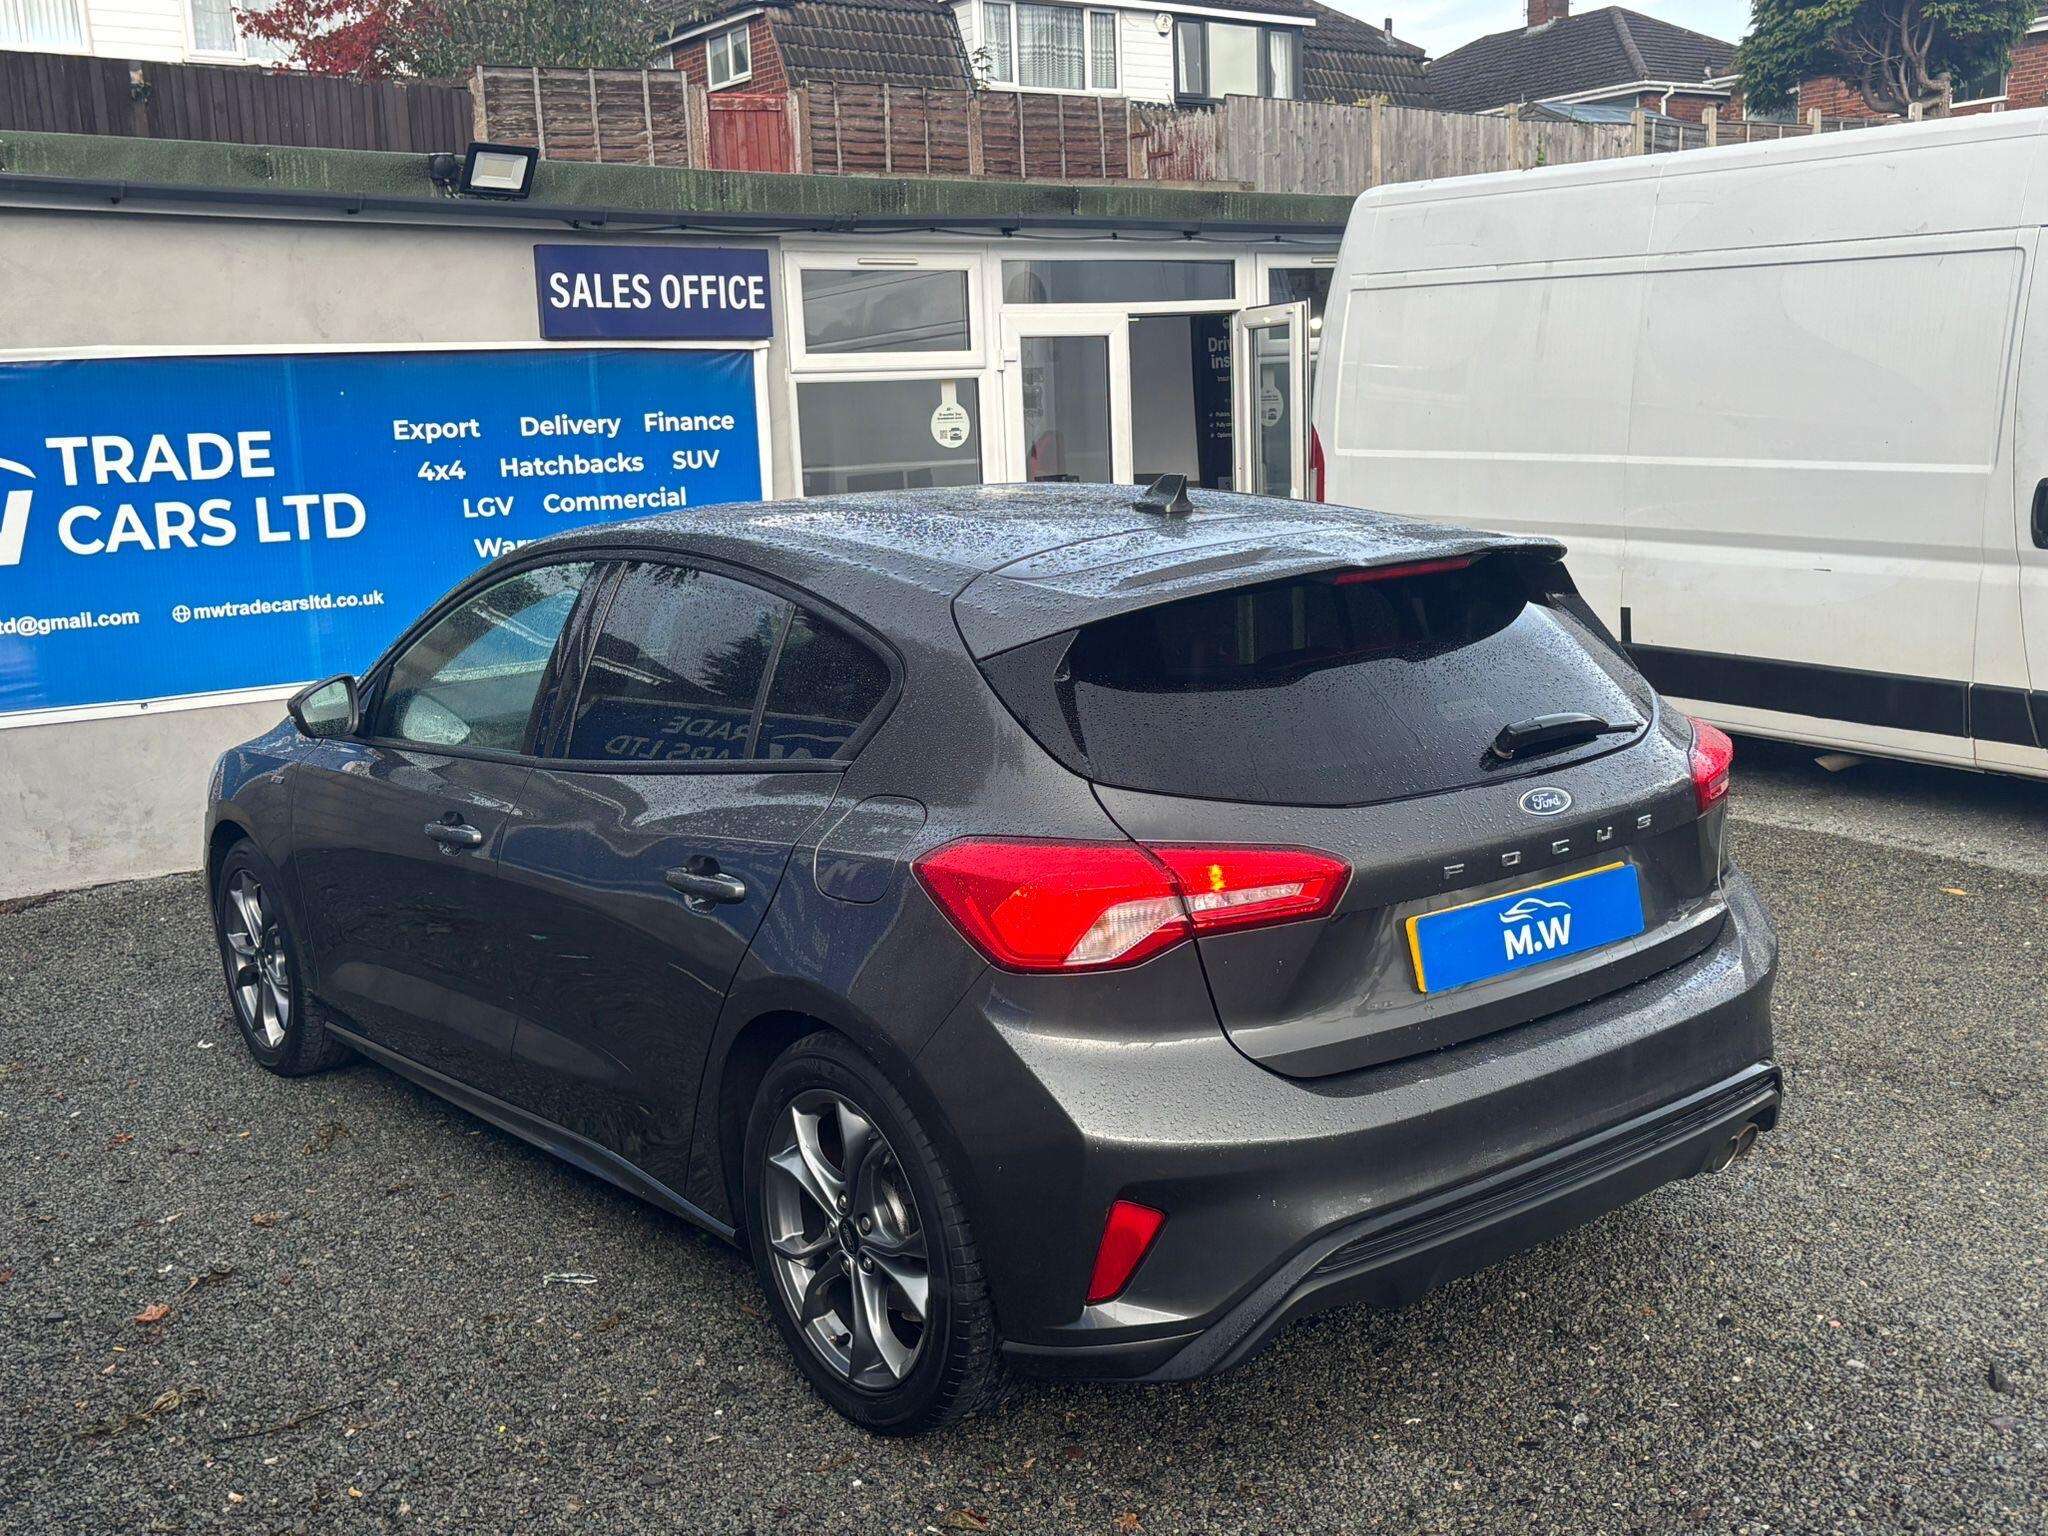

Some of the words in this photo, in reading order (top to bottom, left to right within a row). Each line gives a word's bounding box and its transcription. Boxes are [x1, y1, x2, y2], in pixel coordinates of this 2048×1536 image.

[550, 271, 651, 309] SALES
[660, 273, 766, 310] OFFICE
[393, 418, 481, 444] Export
[520, 413, 622, 439] Delivery
[643, 411, 736, 433] Finance
[45, 430, 276, 487] TRADE
[417, 460, 466, 482] 4x4
[499, 452, 645, 479] Hatchbacks
[672, 449, 720, 471] SUV
[462, 496, 514, 519] LGV
[542, 487, 688, 515] Commercial
[57, 498, 238, 556] CARS
[255, 492, 367, 544] LTD
[193, 589, 385, 621] mwtradecarsltd.co.uk
[1530, 792, 1562, 810] Ford
[1443, 813, 1652, 880] FOCUS
[1503, 912, 1572, 961] M.W
